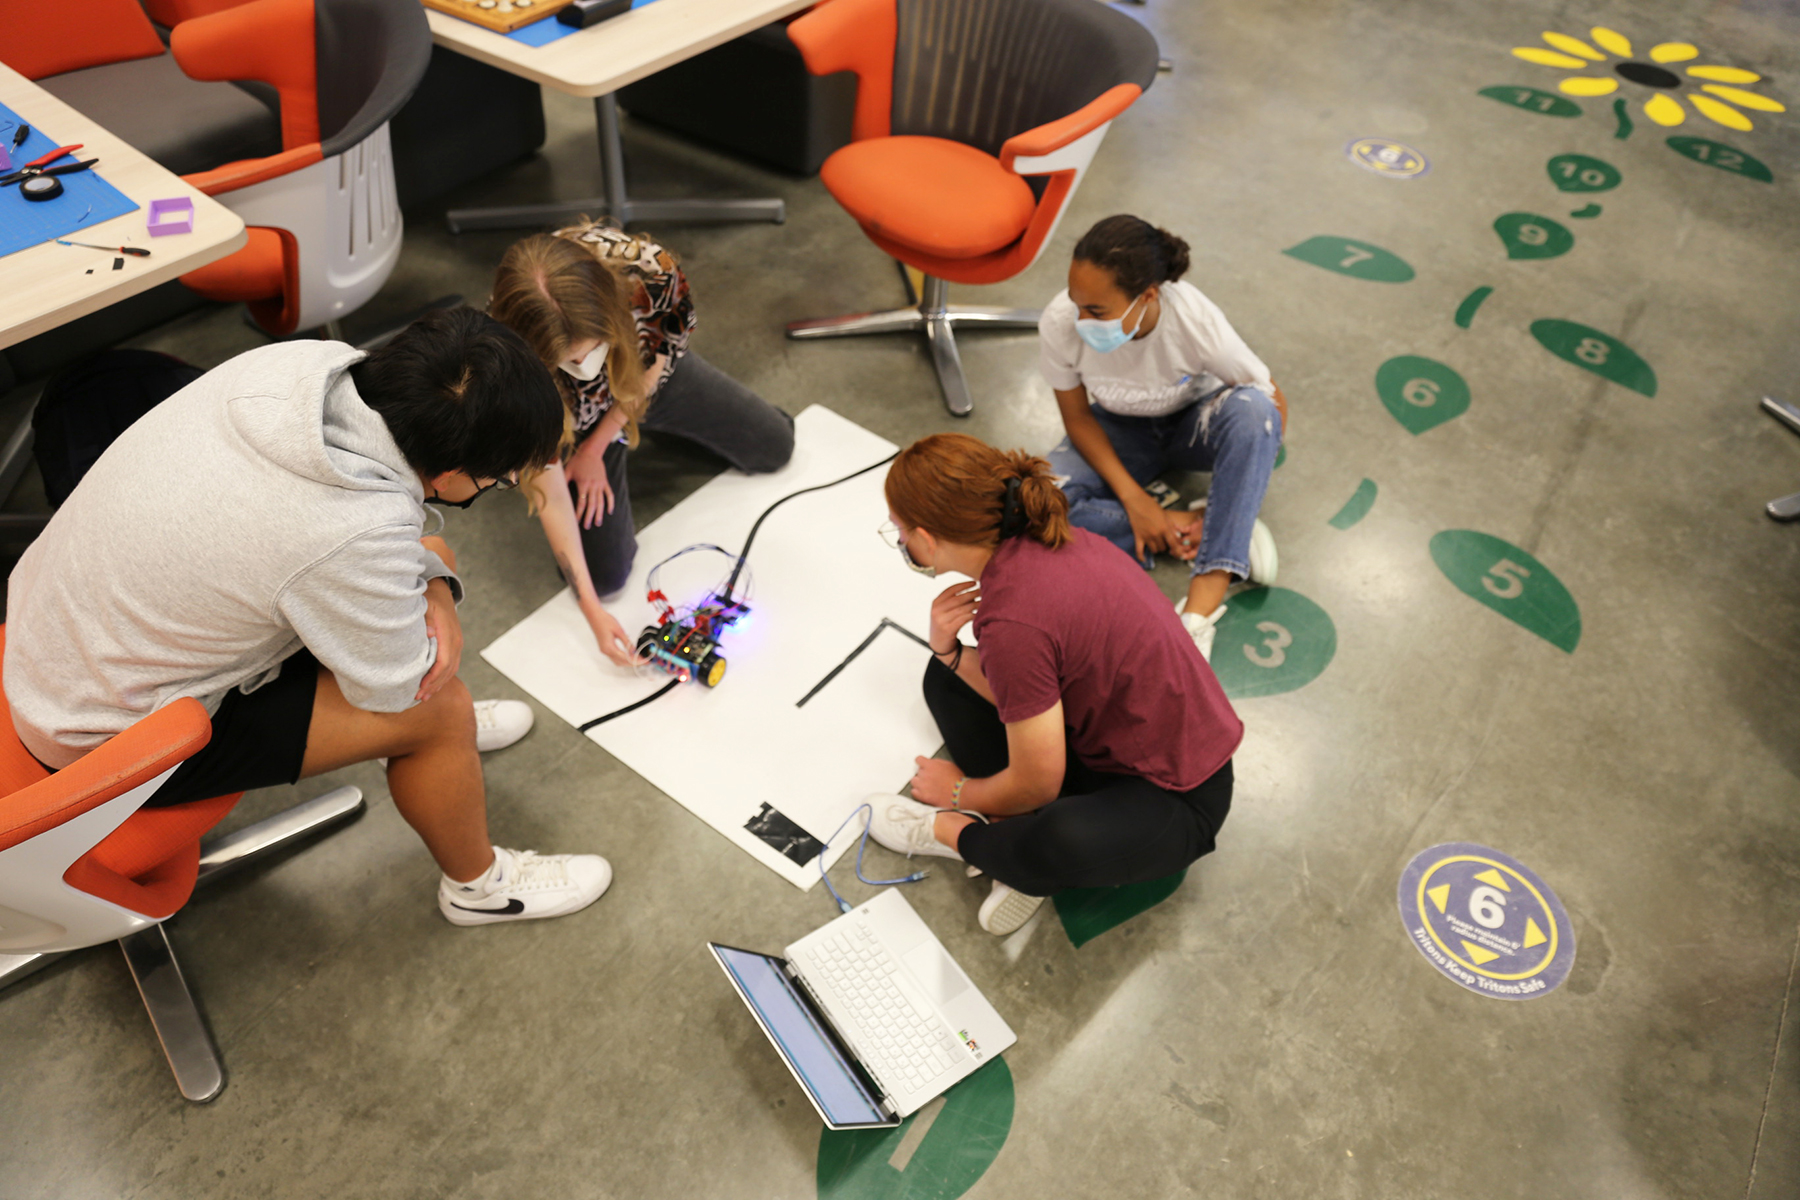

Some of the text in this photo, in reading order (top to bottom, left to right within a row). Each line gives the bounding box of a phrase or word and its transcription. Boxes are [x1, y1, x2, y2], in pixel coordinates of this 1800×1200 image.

[1513, 90, 1555, 112] 11
[1691, 143, 1746, 170] 12
[1558, 161, 1606, 186] 10
[1518, 223, 1549, 246] 9
[1340, 245, 1374, 268] 7
[1574, 337, 1611, 365] 8
[1402, 377, 1441, 407] 6
[1481, 558, 1531, 599] 5
[1243, 621, 1293, 668] 3
[1469, 886, 1507, 929] 6
[1446, 914, 1474, 932] Please
[1451, 925, 1477, 940] radius
[1414, 926, 1546, 994] Tritons Keep Tritons Safe
